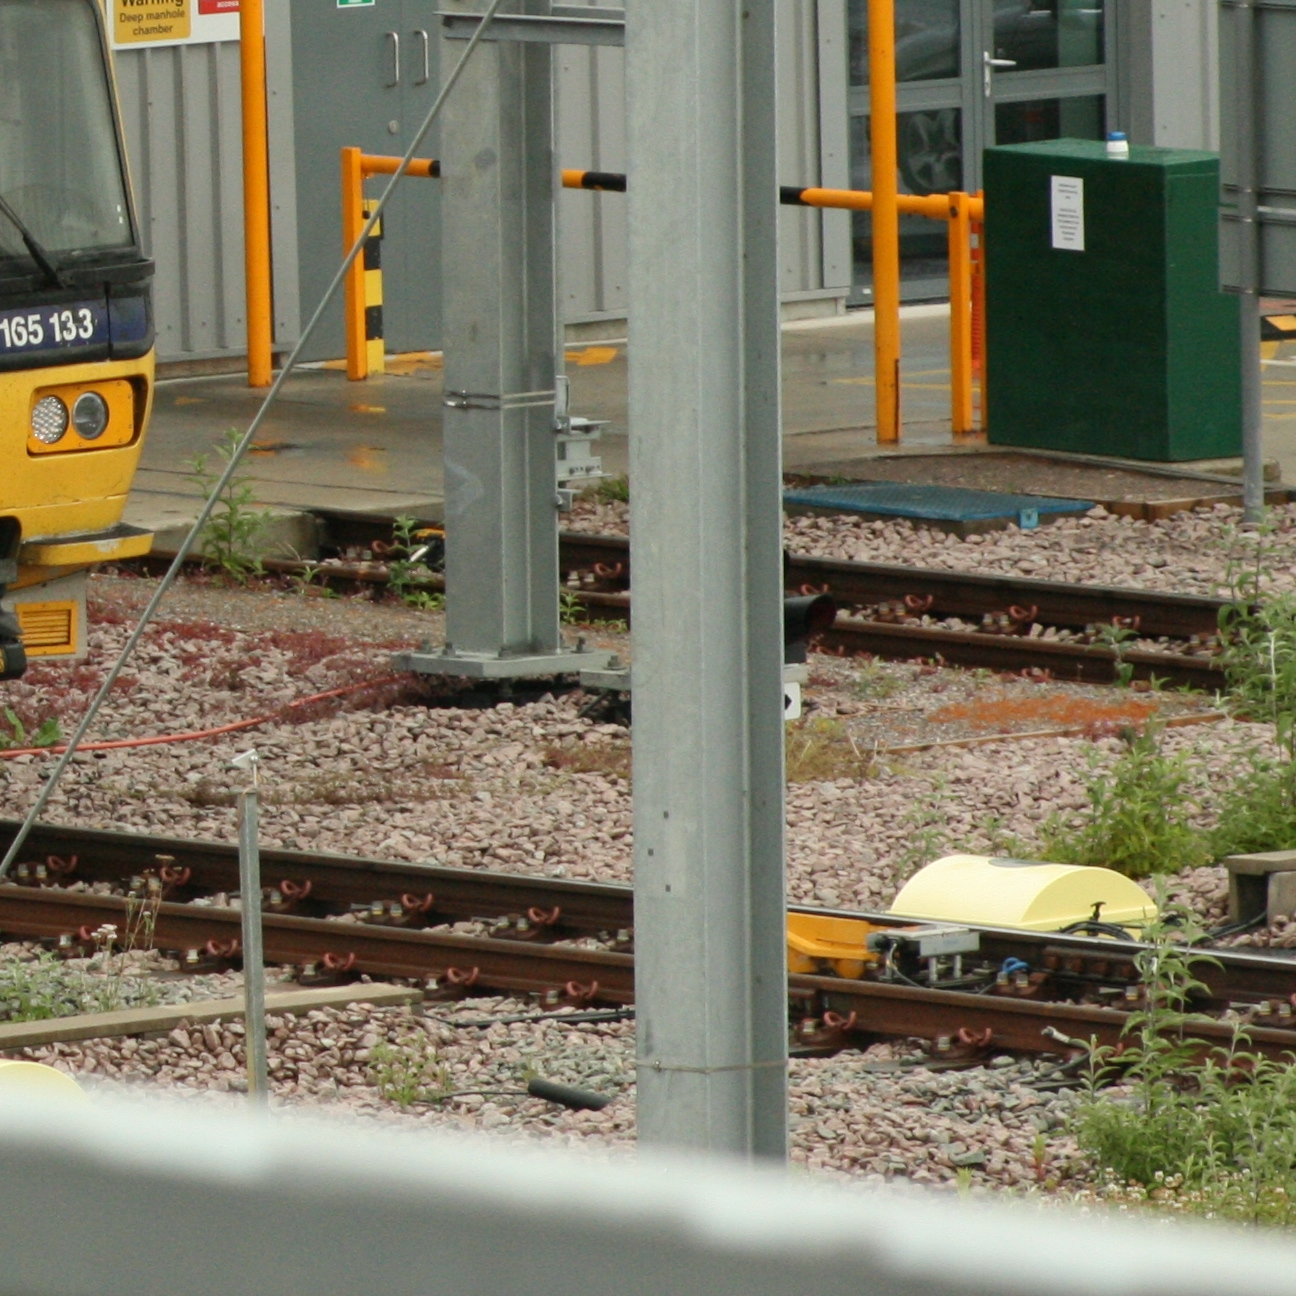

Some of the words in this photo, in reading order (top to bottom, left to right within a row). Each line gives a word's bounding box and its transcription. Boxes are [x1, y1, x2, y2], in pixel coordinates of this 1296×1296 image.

[119, 12, 144, 23] Deep
[146, 9, 186, 21] manhole
[132, 24, 174, 36] chamber
[48, 308, 95, 343] 133
